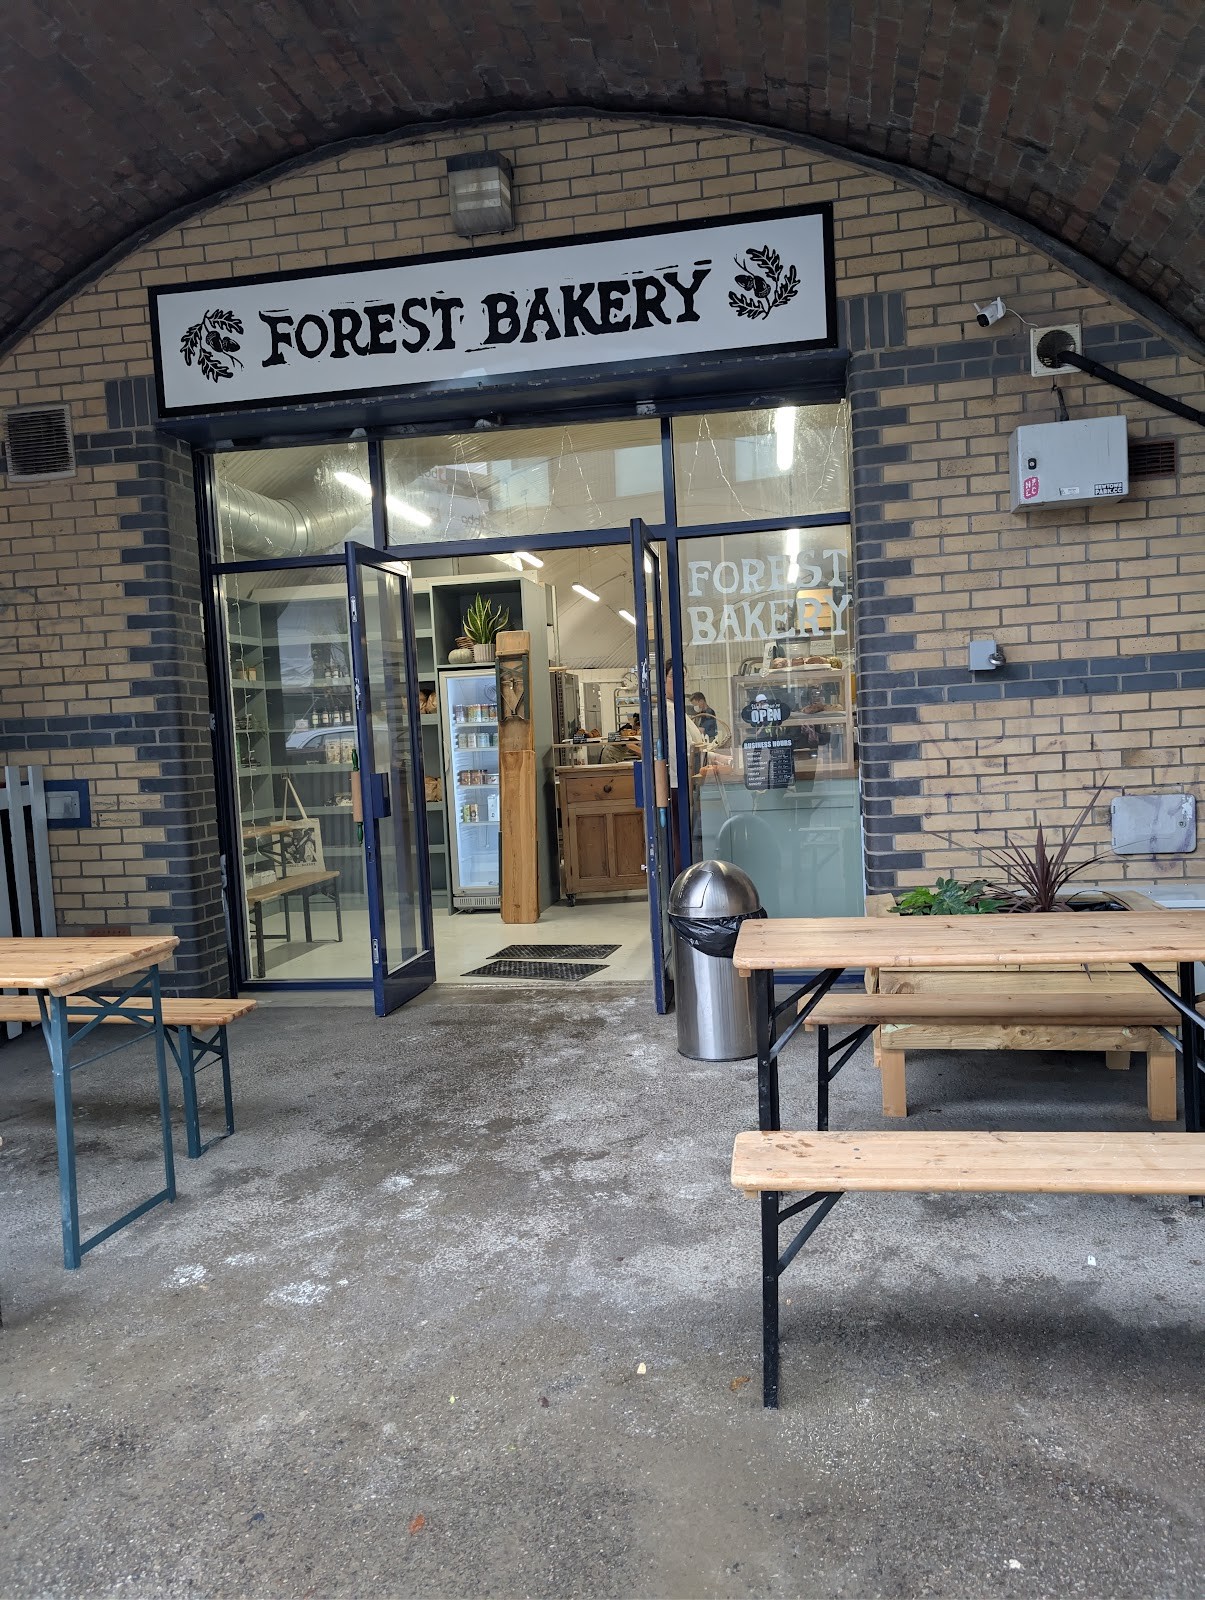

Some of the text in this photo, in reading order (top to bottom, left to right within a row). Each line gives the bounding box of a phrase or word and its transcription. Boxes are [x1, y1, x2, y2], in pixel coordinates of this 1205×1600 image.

[259, 265, 711, 367] FOREST BAKERY
[688, 549, 848, 597] FOREST
[687, 594, 853, 645] BAKERY
[751, 709, 781, 722] OPEN
[743, 740, 792, 749] BUSINESS HOURS
